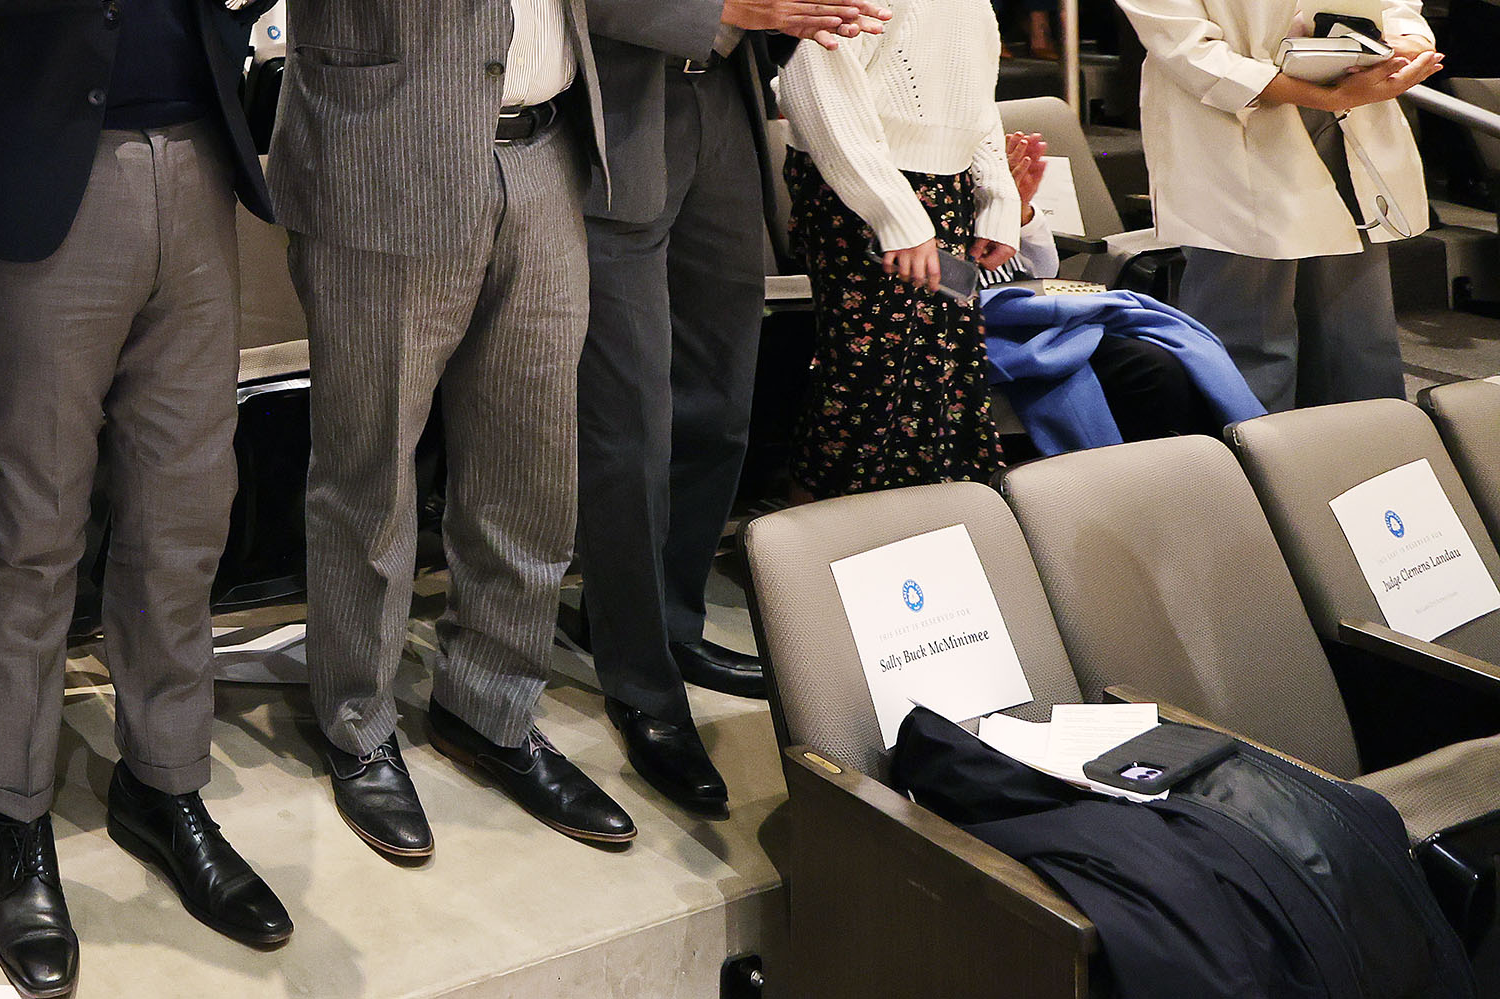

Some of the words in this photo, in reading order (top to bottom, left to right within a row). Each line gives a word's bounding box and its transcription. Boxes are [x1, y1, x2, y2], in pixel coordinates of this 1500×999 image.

[1382, 576, 1401, 592] Judge
[1400, 561, 1431, 581] Clemens
[1429, 548, 1461, 567] Landau
[880, 654, 903, 672] Sally
[903, 645, 927, 663] Buck
[928, 630, 990, 655] McMinimee
